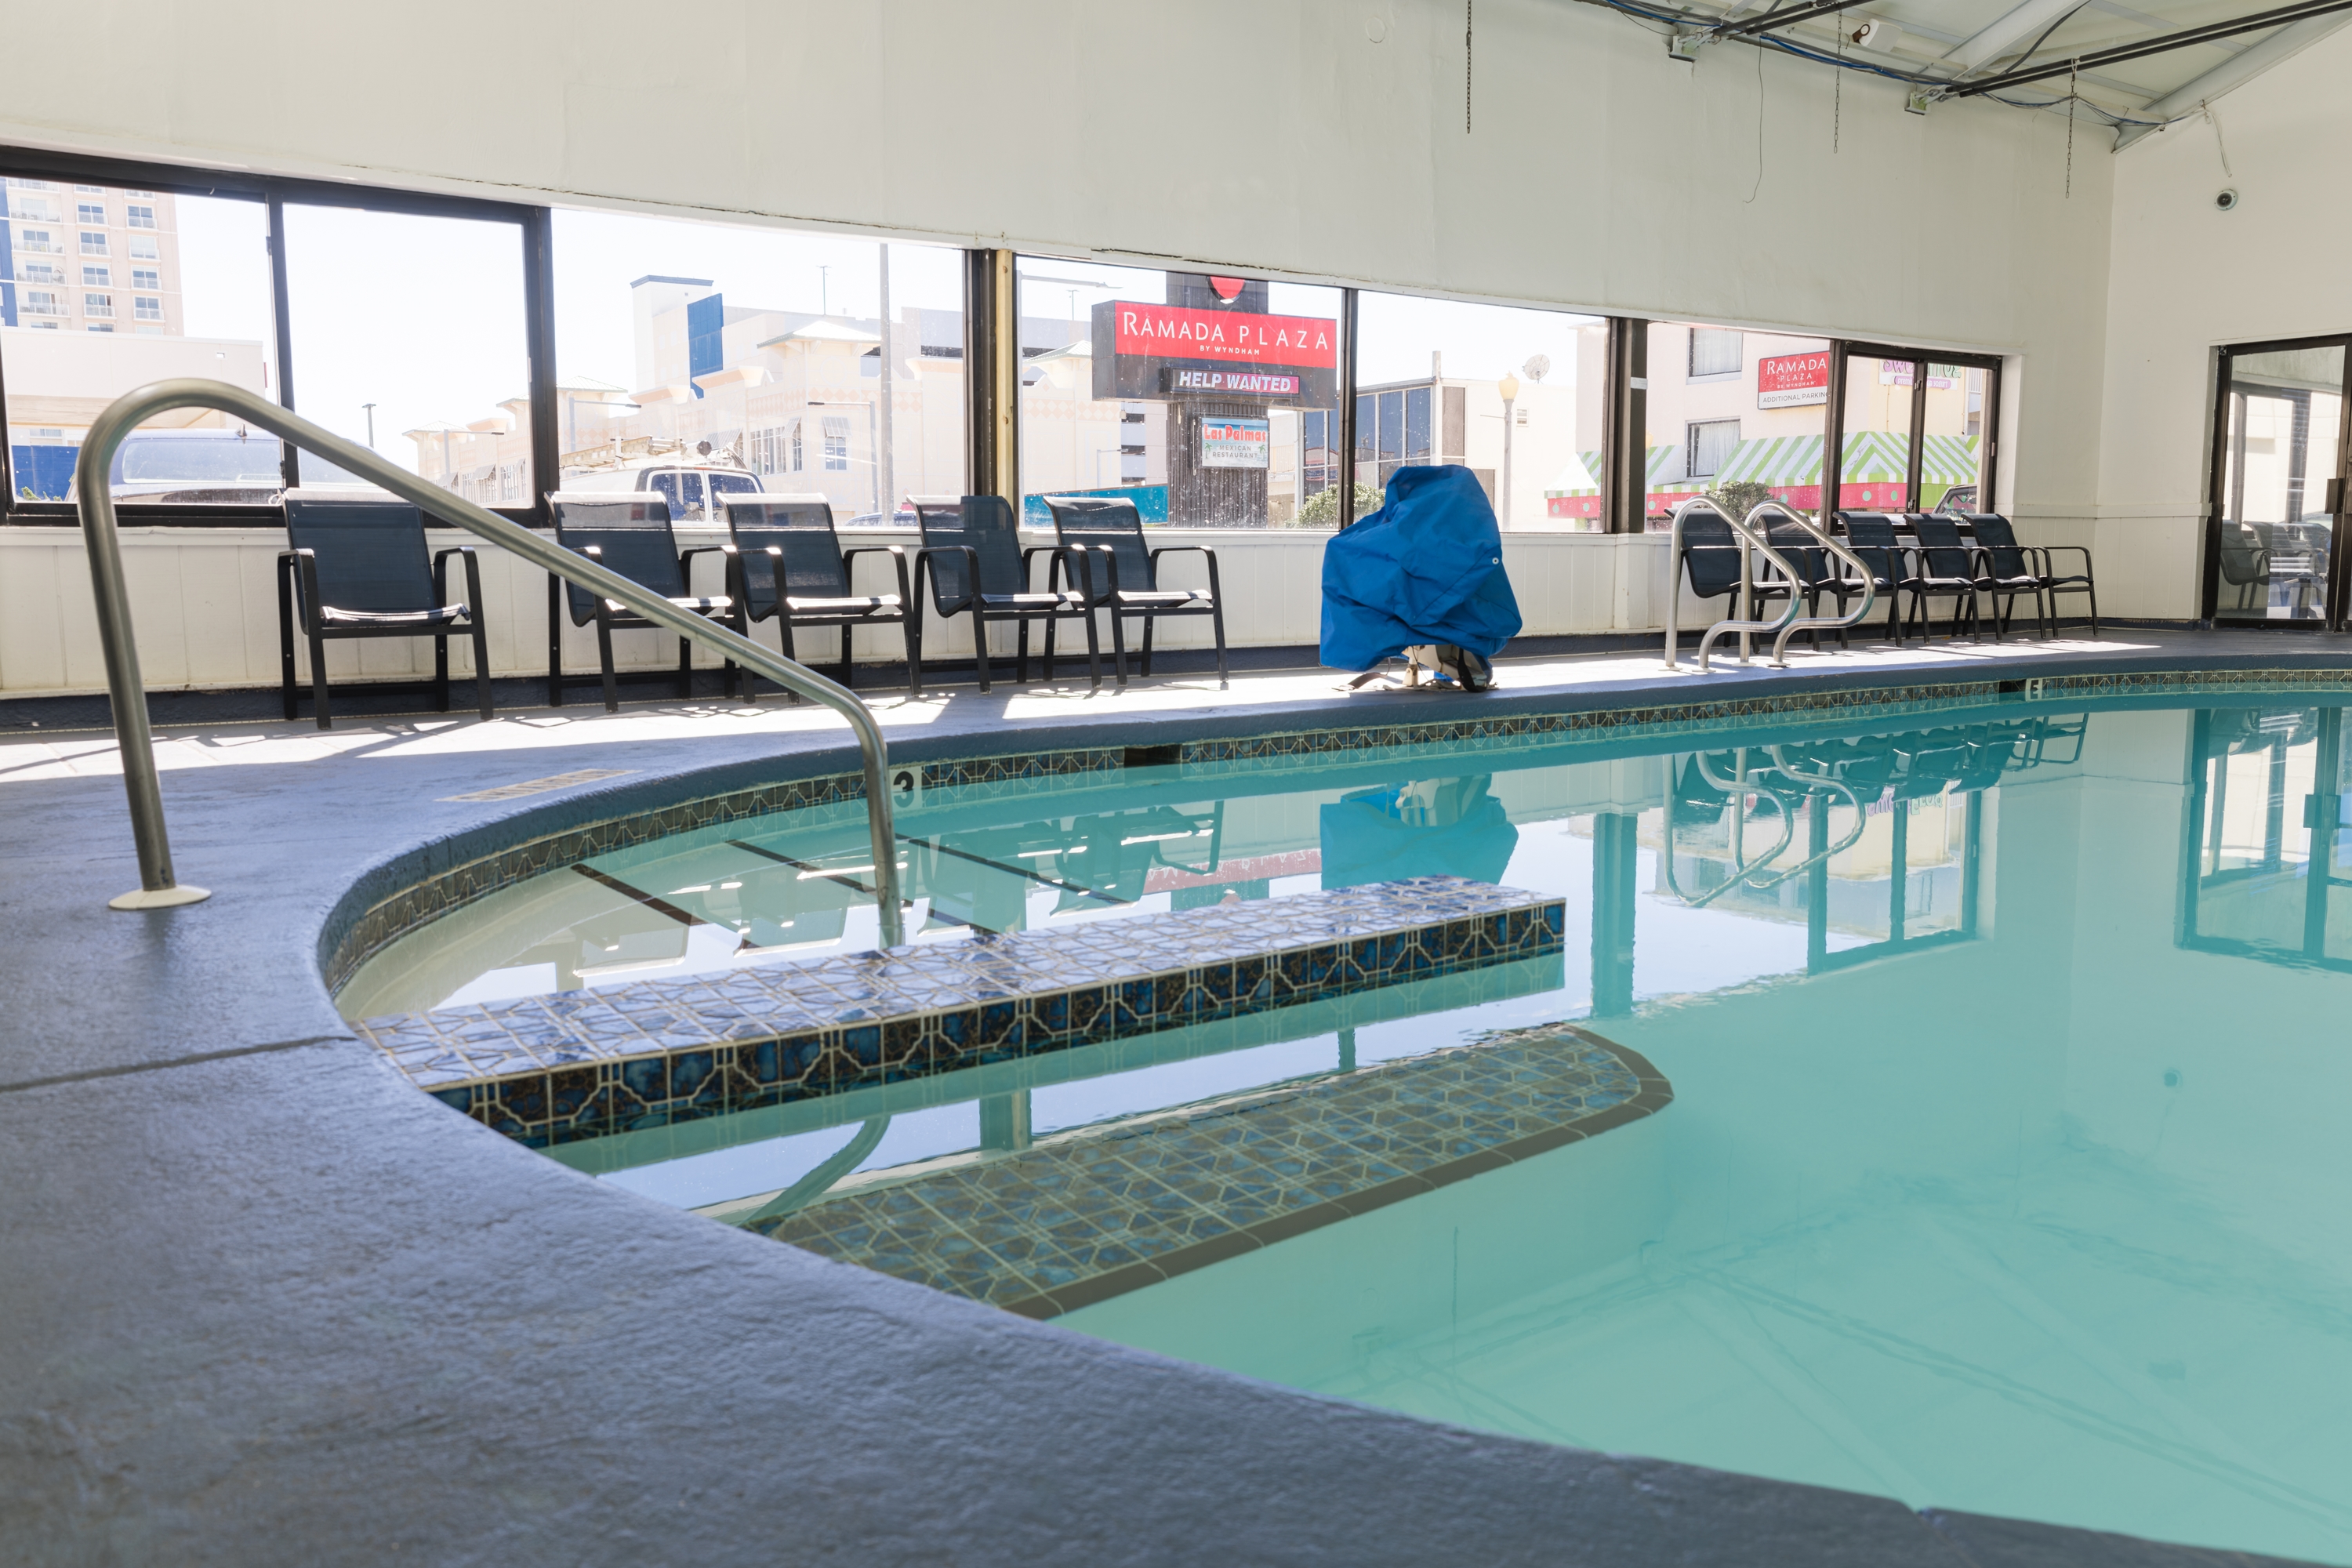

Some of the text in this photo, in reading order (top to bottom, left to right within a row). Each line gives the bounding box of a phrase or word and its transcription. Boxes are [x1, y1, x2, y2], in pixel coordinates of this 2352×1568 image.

[1123, 312, 1328, 350] RAMADA PLAZA
[1214, 347, 1260, 355] WYNDHAM
[1766, 358, 1827, 376] RAMADA
[1179, 371, 1291, 392] HELP WANTED
[1780, 372, 1813, 382] PLAZA
[1762, 394, 1801, 403] ADDITIONAL
[1203, 424, 1266, 443] Las Palmas
